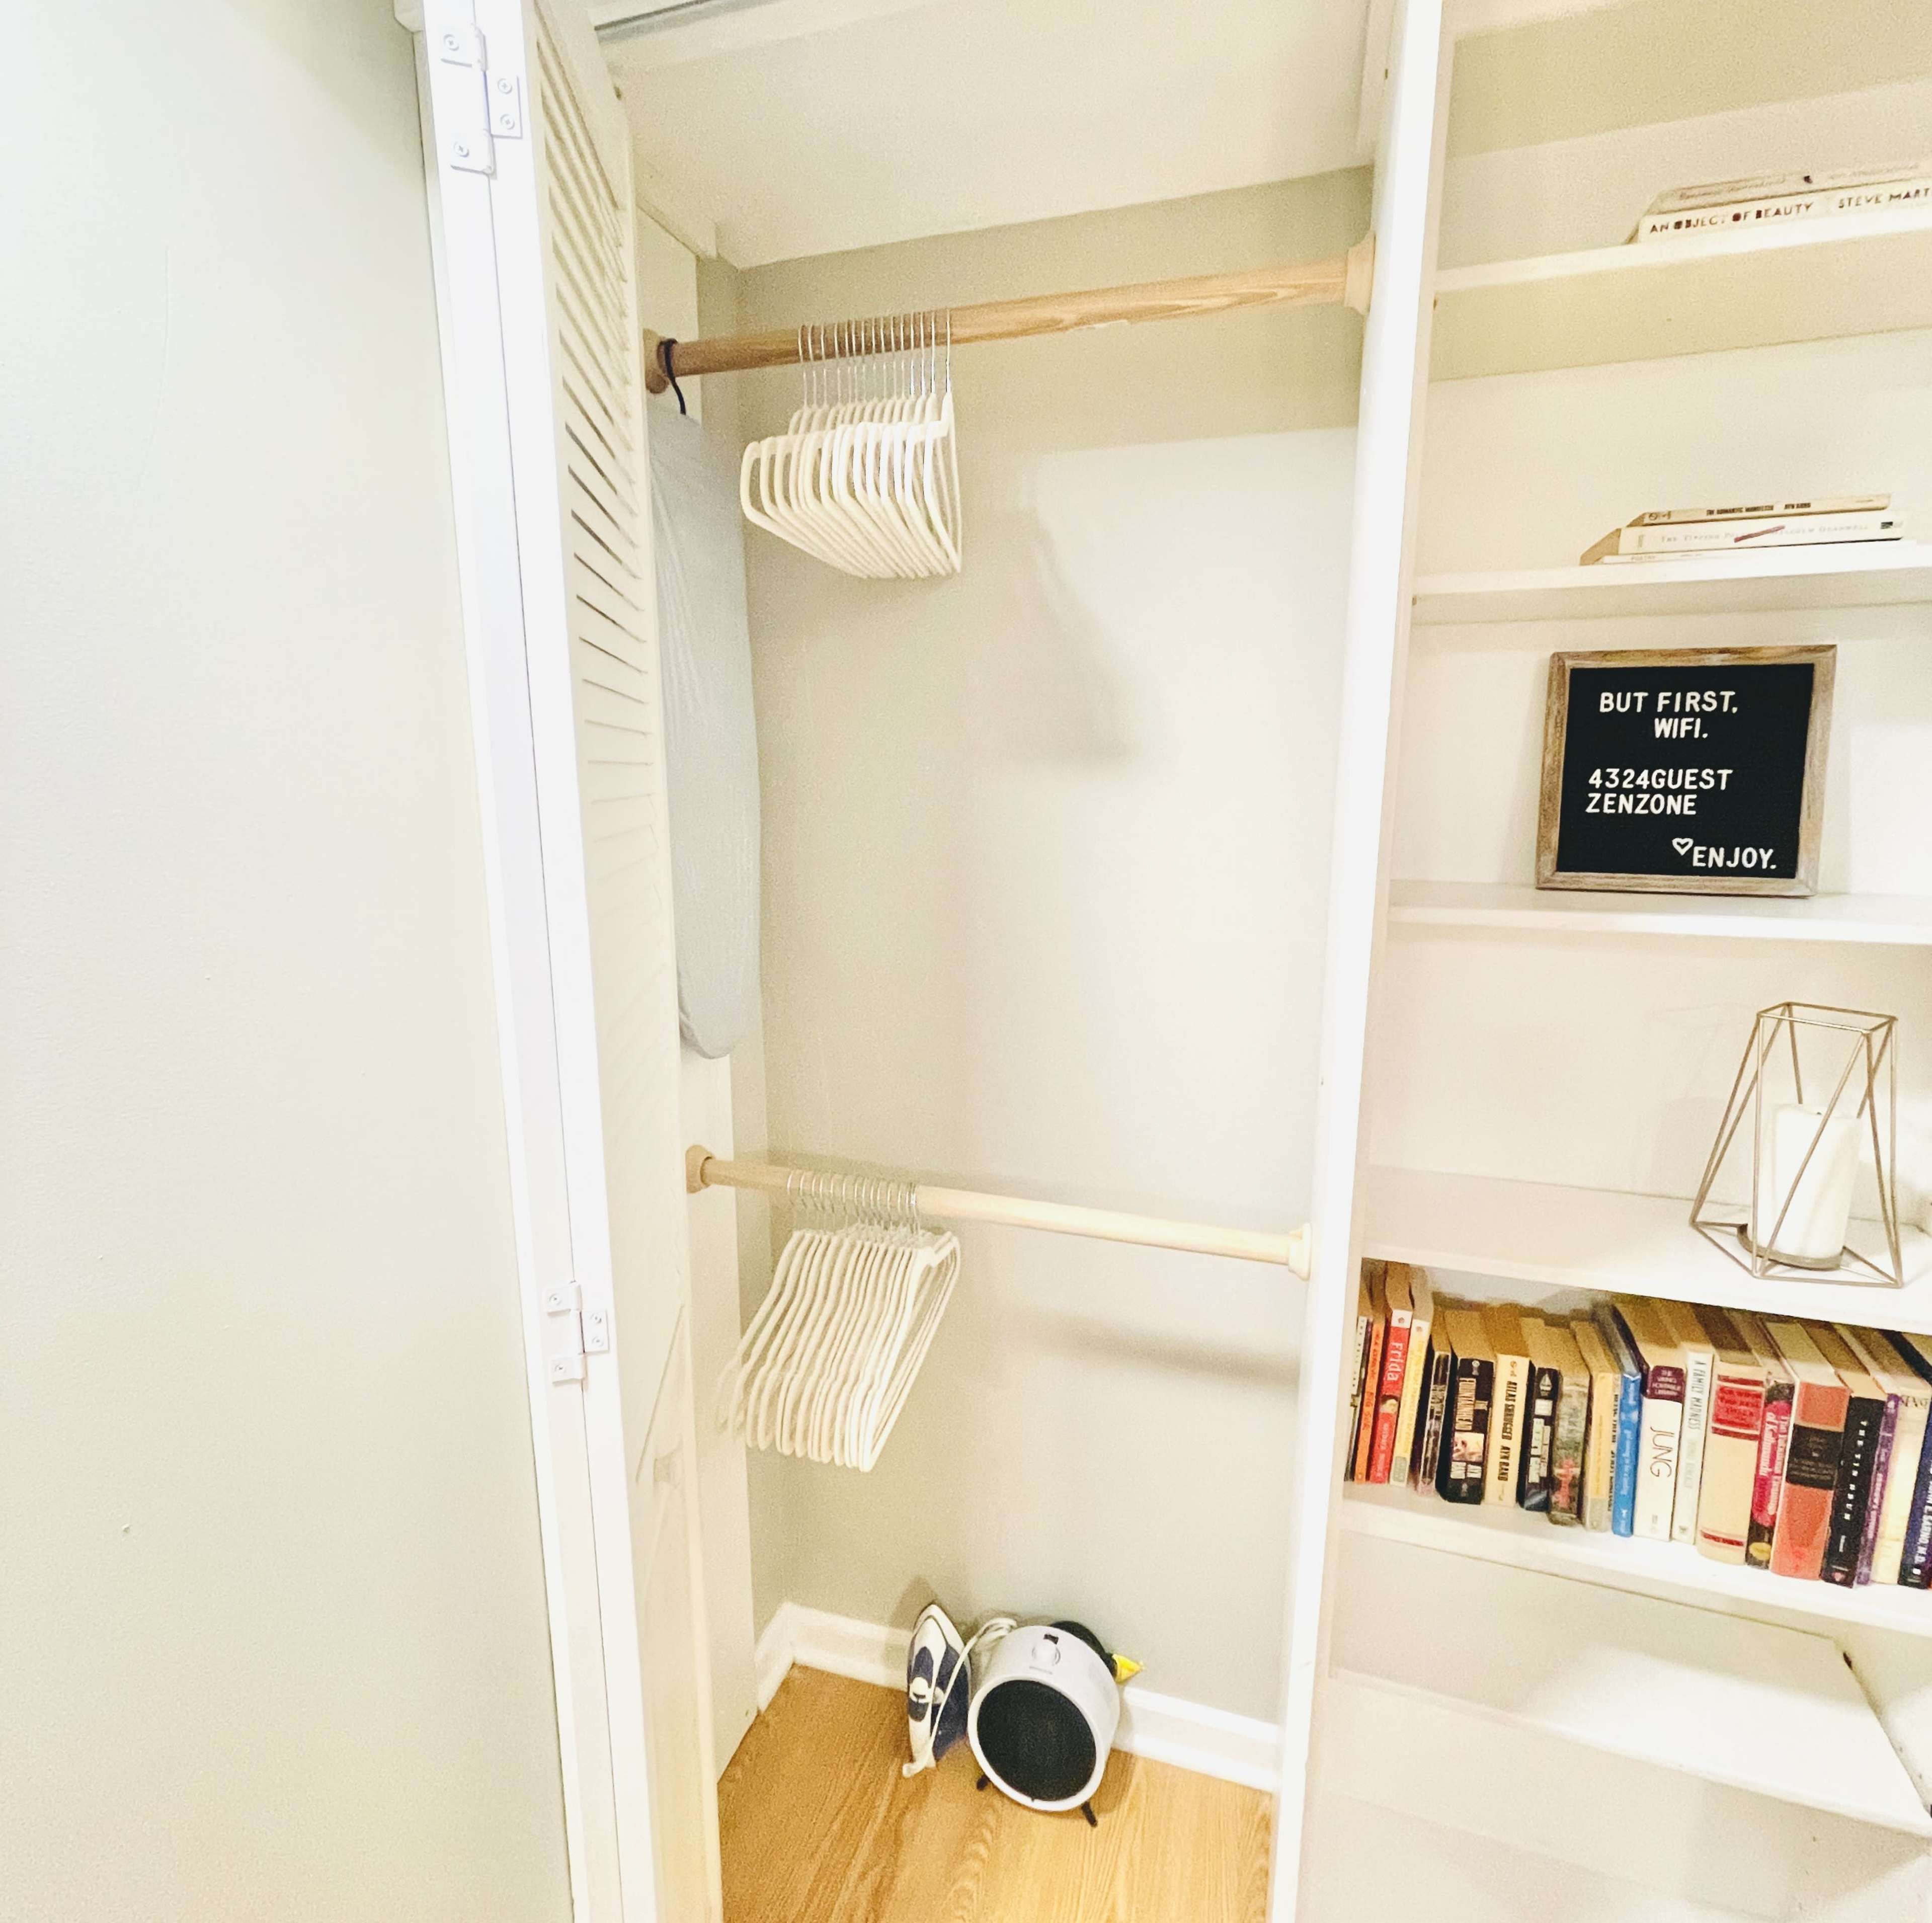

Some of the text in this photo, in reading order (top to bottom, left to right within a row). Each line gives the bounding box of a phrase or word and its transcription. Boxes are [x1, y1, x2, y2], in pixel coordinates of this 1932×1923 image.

[1838, 193, 1883, 209] STEVE
[1650, 222, 1669, 234] AN
[1732, 210, 1750, 222] OF
[1755, 201, 1814, 219] BEAUTY
[1600, 692, 1648, 712] BUT
[1655, 718, 1708, 739] WIFI.
[1589, 768, 1733, 790] 4324GUEST
[1586, 793, 1697, 815] ZENZONE
[1693, 846, 1777, 869] ENJOY.
[1387, 1342, 1404, 1381] Frida
[1691, 1368, 1706, 1396] FAMILY
[1687, 1397, 1703, 1430] MADNESS
[1650, 1425, 1675, 1478] JUNG
